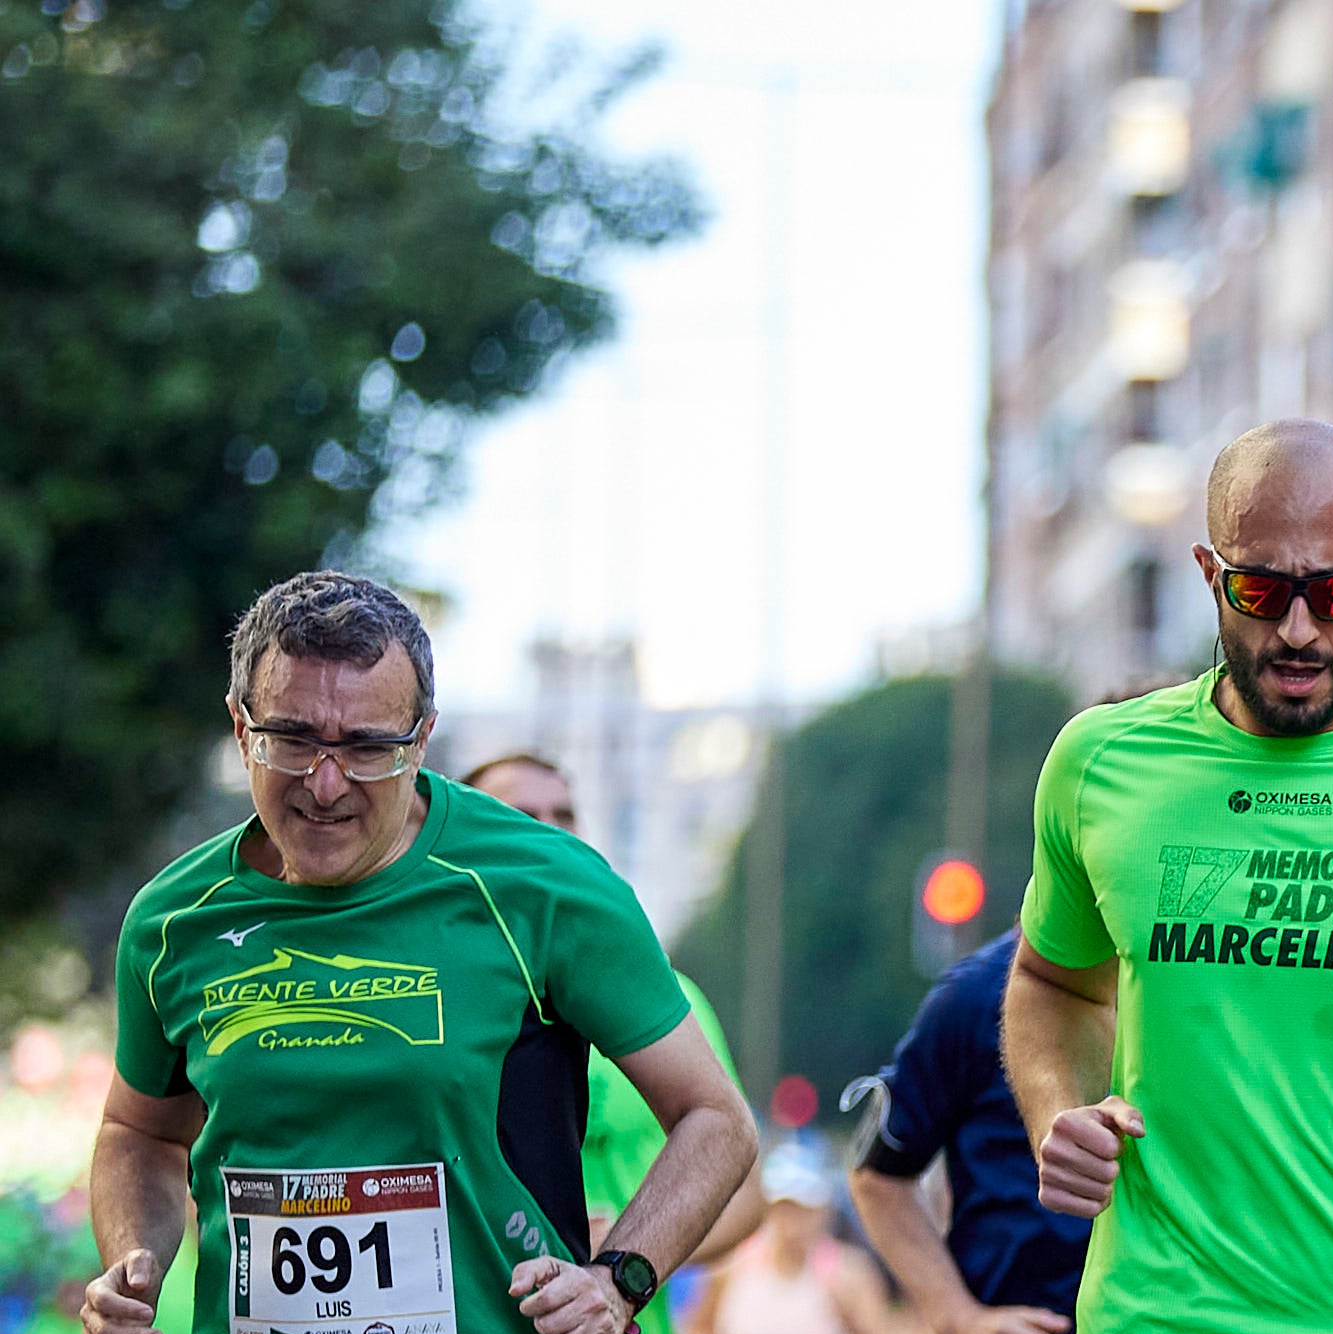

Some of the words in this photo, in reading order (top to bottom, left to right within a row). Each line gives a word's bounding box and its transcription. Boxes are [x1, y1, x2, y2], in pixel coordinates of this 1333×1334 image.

[1256, 791, 1332, 806] OXIMESA
[1254, 806, 1294, 816] NIPPON
[1297, 806, 1332, 816] GASES
[1157, 845, 1250, 918] 17
[203, 980, 317, 1011] PUENTE
[329, 972, 438, 999] VERDE
[258, 1027, 365, 1051] Granada
[281, 1175, 302, 1201] 17
[301, 1173, 348, 1187] MEMORIAL
[381, 1174, 433, 1188] OXIMESA
[303, 1185, 345, 1200] PADRE
[281, 1198, 351, 1215] MARCELINO
[239, 1234, 249, 1246] 3
[271, 1220, 394, 1296] 691
[238, 1249, 249, 1297] CAJÓN
[316, 1300, 352, 1319] LUIS
